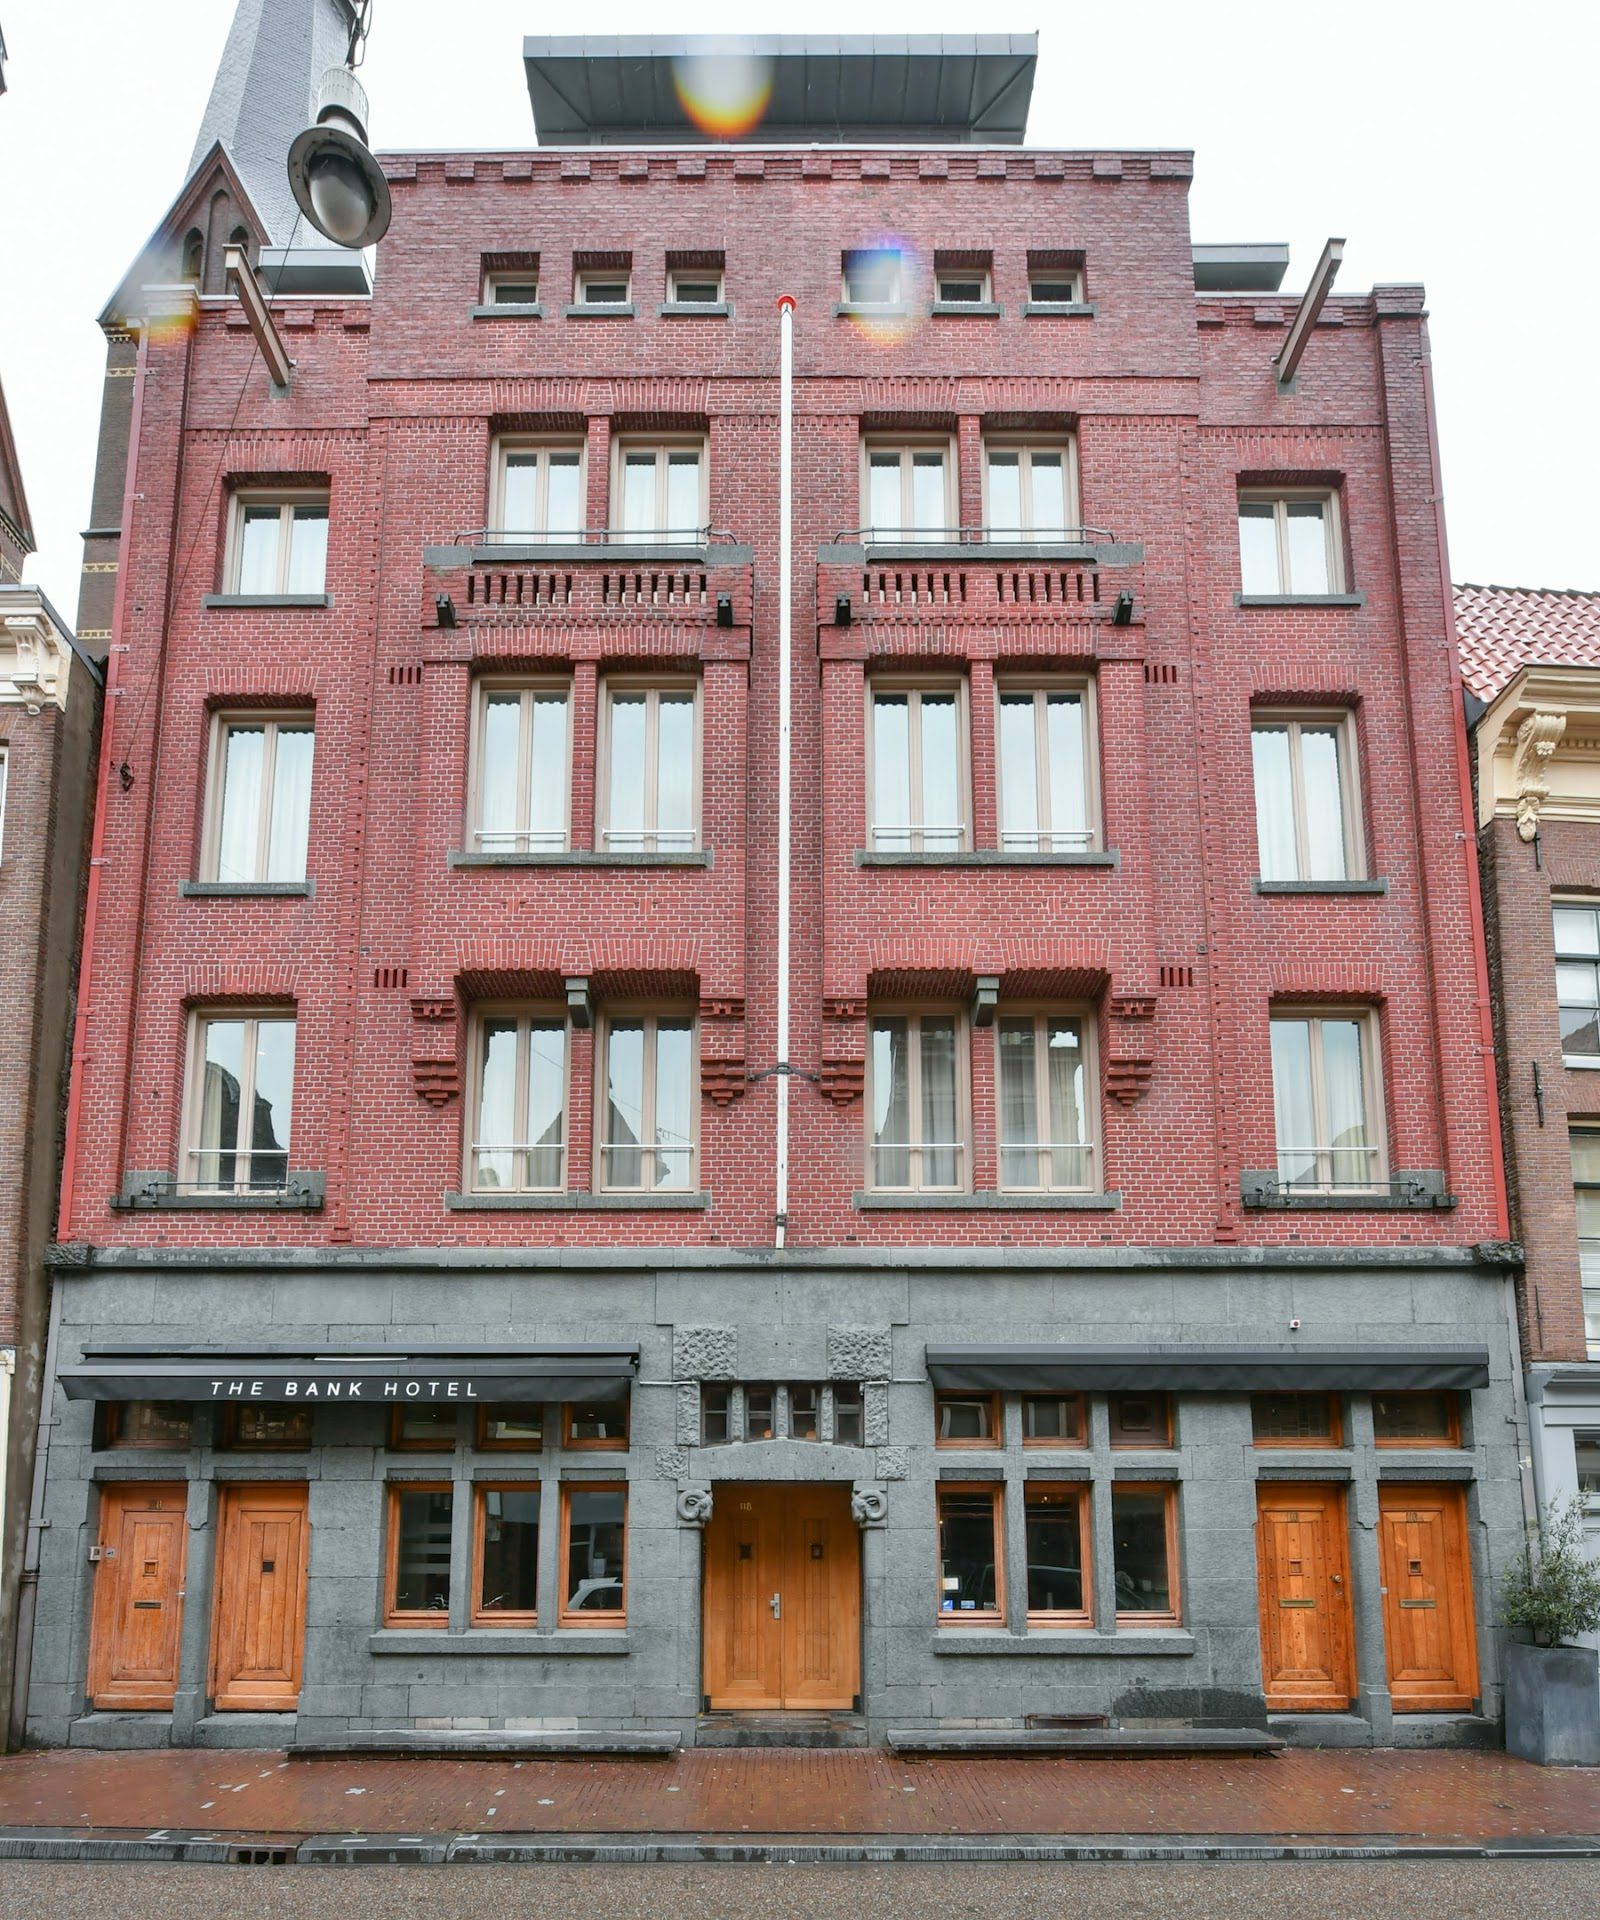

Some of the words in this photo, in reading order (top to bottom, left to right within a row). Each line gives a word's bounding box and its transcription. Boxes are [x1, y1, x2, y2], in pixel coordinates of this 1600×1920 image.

[211, 1382, 264, 1396] THE
[285, 1382, 363, 1396] BANK
[384, 1382, 478, 1397] HOTEL
